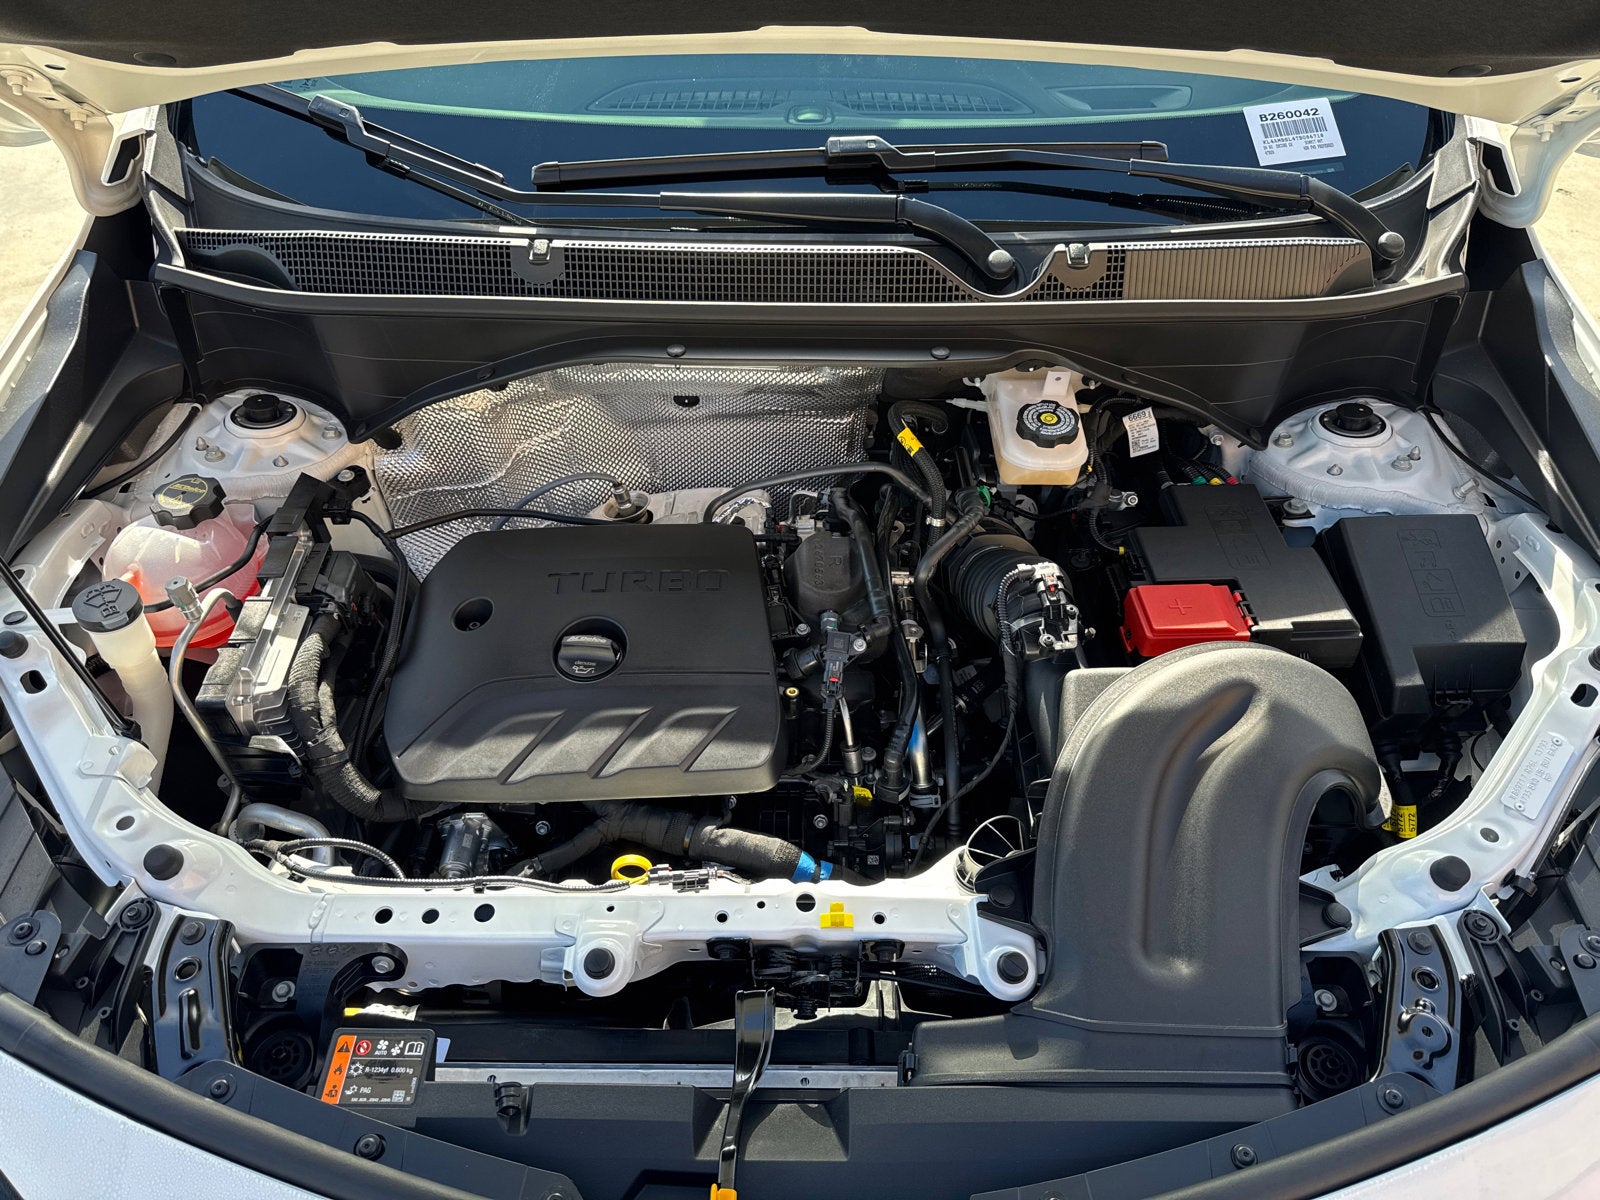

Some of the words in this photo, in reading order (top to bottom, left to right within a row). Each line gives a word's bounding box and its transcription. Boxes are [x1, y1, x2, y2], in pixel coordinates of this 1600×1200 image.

[1259, 108, 1320, 122] B260042
[1128, 411, 1146, 421] 6669
[548, 569, 729, 594] TURBO
